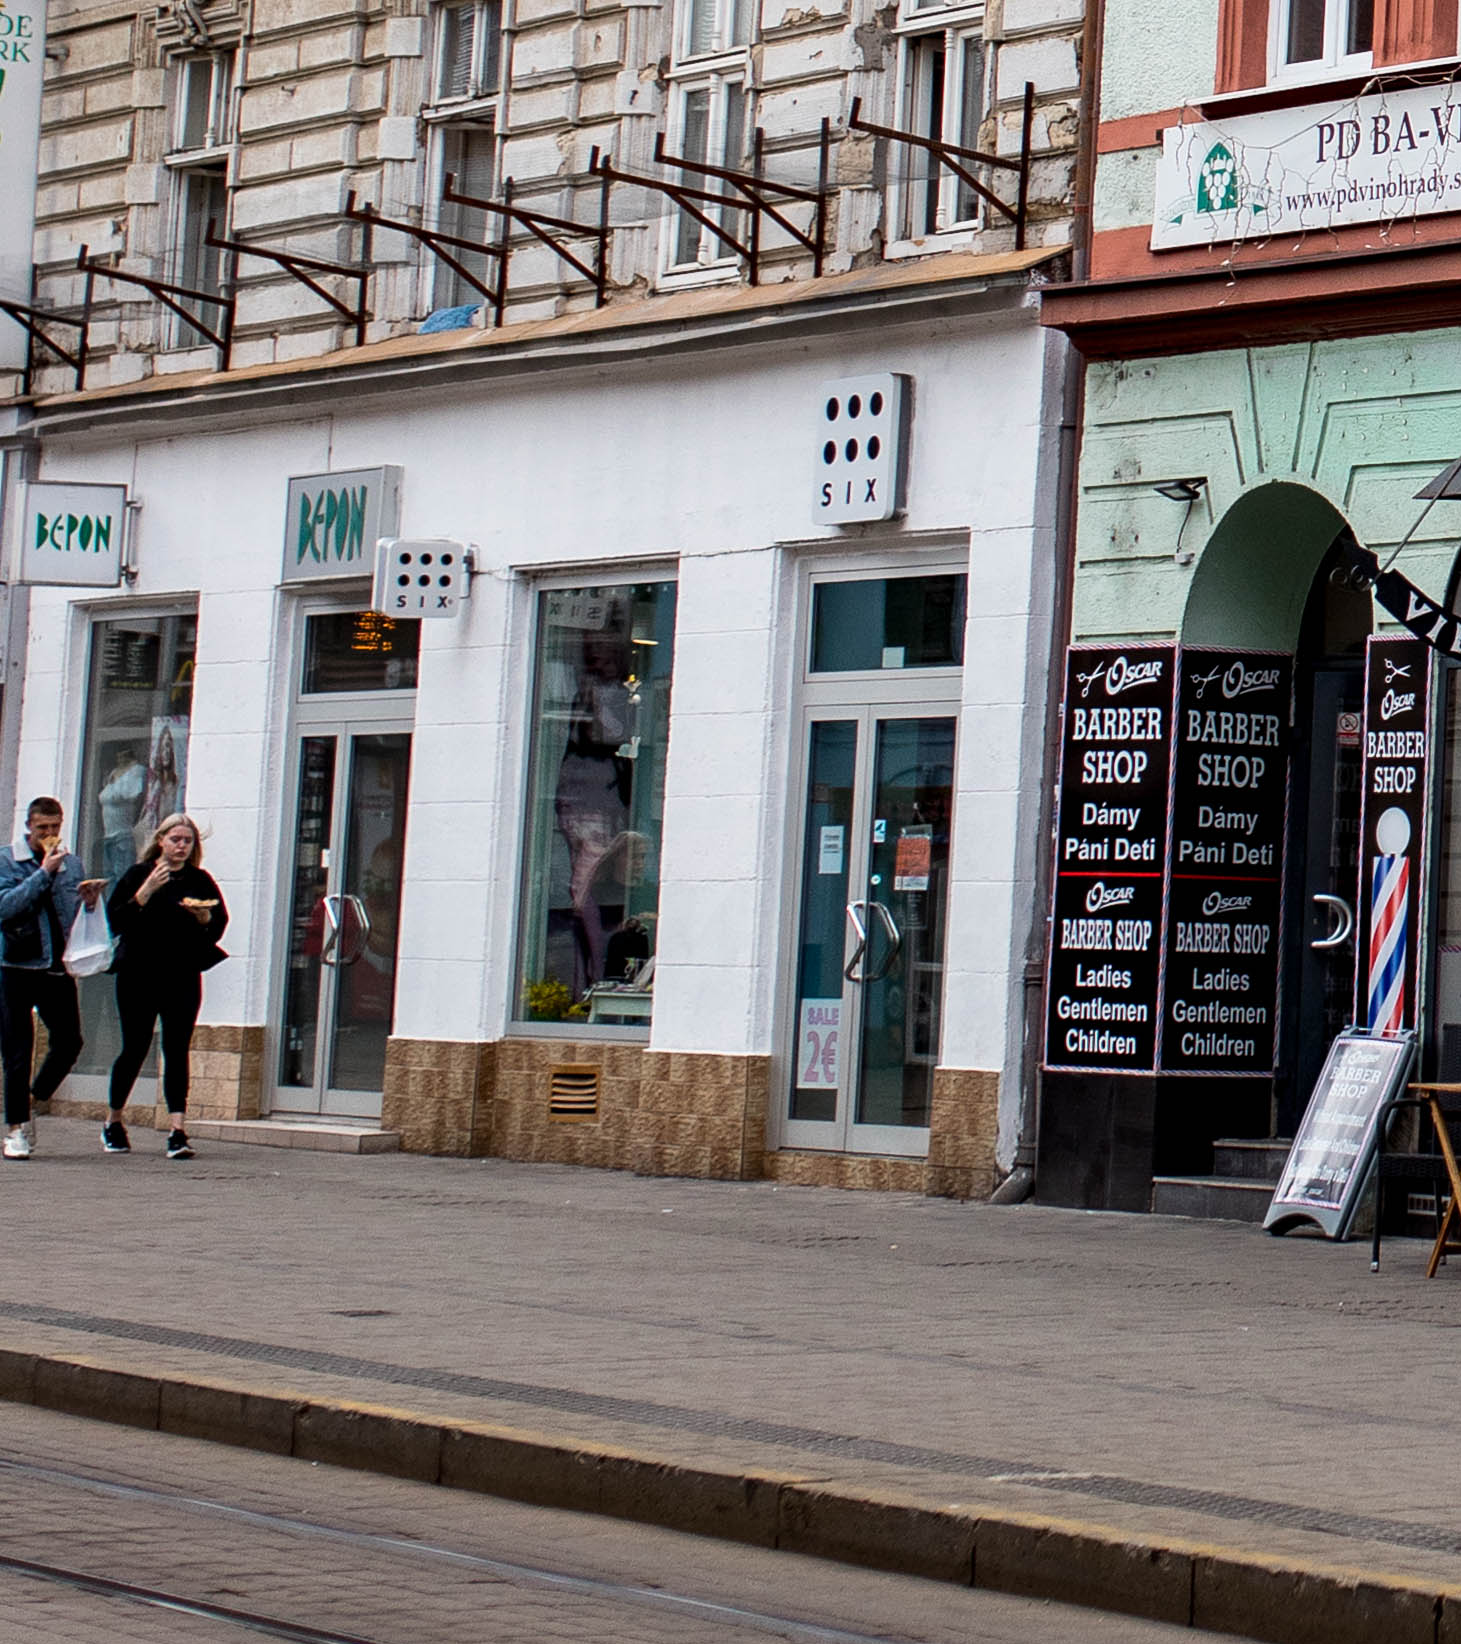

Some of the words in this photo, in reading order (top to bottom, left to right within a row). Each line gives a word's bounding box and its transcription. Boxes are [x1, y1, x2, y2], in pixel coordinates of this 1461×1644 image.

[1316, 119, 1361, 163] PD
[820, 478, 878, 508] SIX
[396, 595, 448, 609] SIX
[1072, 707, 1163, 741] BARBER
[1186, 709, 1280, 747] BARBER
[1366, 731, 1425, 759] BARBER
[1081, 750, 1148, 785] SHOP
[1197, 753, 1265, 789] SHOP
[1373, 766, 1417, 794] SHOP
[1081, 801, 1141, 831] Dámy
[1197, 805, 1259, 836] Dámy
[1064, 837, 1109, 861] Páni
[1114, 837, 1156, 861] Deti
[1178, 840, 1226, 864] Páni
[1231, 842, 1274, 866] Deti
[1060, 918, 1113, 951] BARBER
[1115, 919, 1153, 952] SHOP
[1175, 922, 1231, 954] BARBER
[1233, 923, 1271, 955] SHOP
[1075, 963, 1132, 989] Ladies
[1192, 967, 1250, 992] Ladies
[807, 1007, 840, 1027] SALE
[1057, 995, 1148, 1023] Gentlemen
[1172, 999, 1267, 1025] Gentlemen
[1065, 1028, 1137, 1055] Children
[1181, 1032, 1255, 1057] Children
[803, 1030, 839, 1084] 2€
[1329, 1066, 1383, 1084] BARBER
[1329, 1083, 1368, 1099] SHOP
